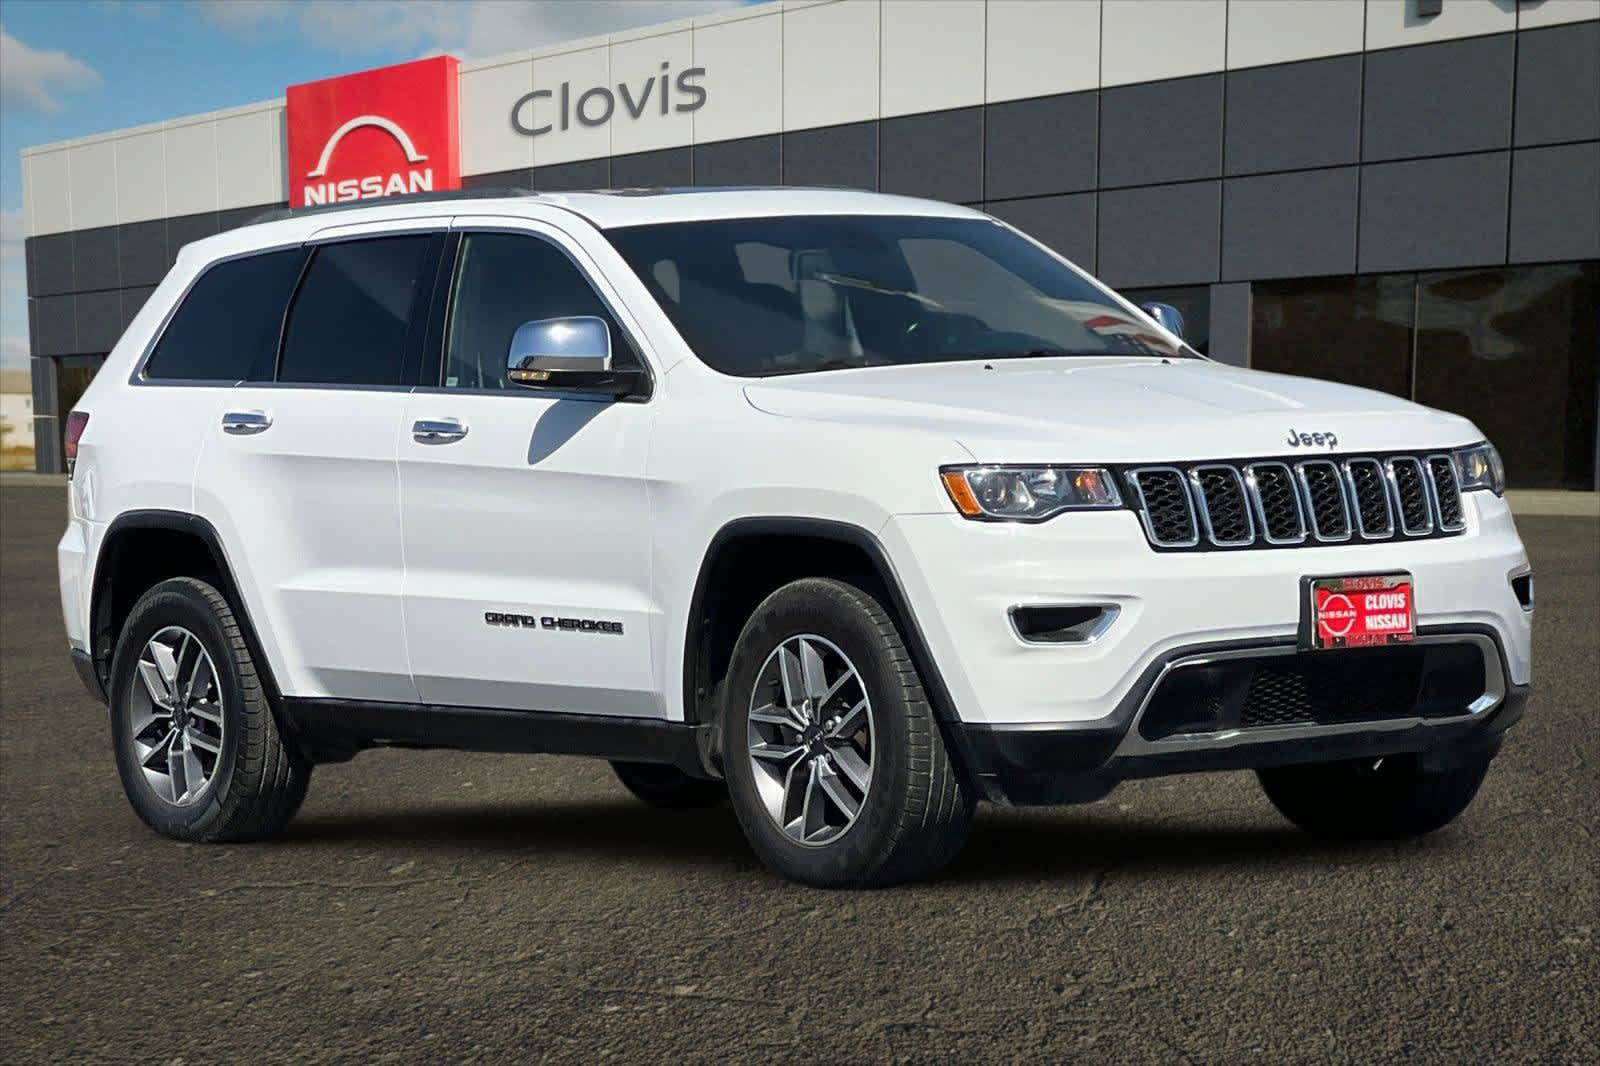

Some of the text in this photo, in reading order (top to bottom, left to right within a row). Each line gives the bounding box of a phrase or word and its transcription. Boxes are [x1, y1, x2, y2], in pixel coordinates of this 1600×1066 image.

[511, 62, 707, 137] Clovis
[304, 168, 433, 206] NISSAN
[1287, 428, 1338, 449] Jeep
[1365, 593, 1406, 611] CLOVIS
[485, 612, 624, 635] GRAND CHEROKEE
[1318, 610, 1357, 619] NISSAN
[1365, 613, 1407, 630] NISSAN
